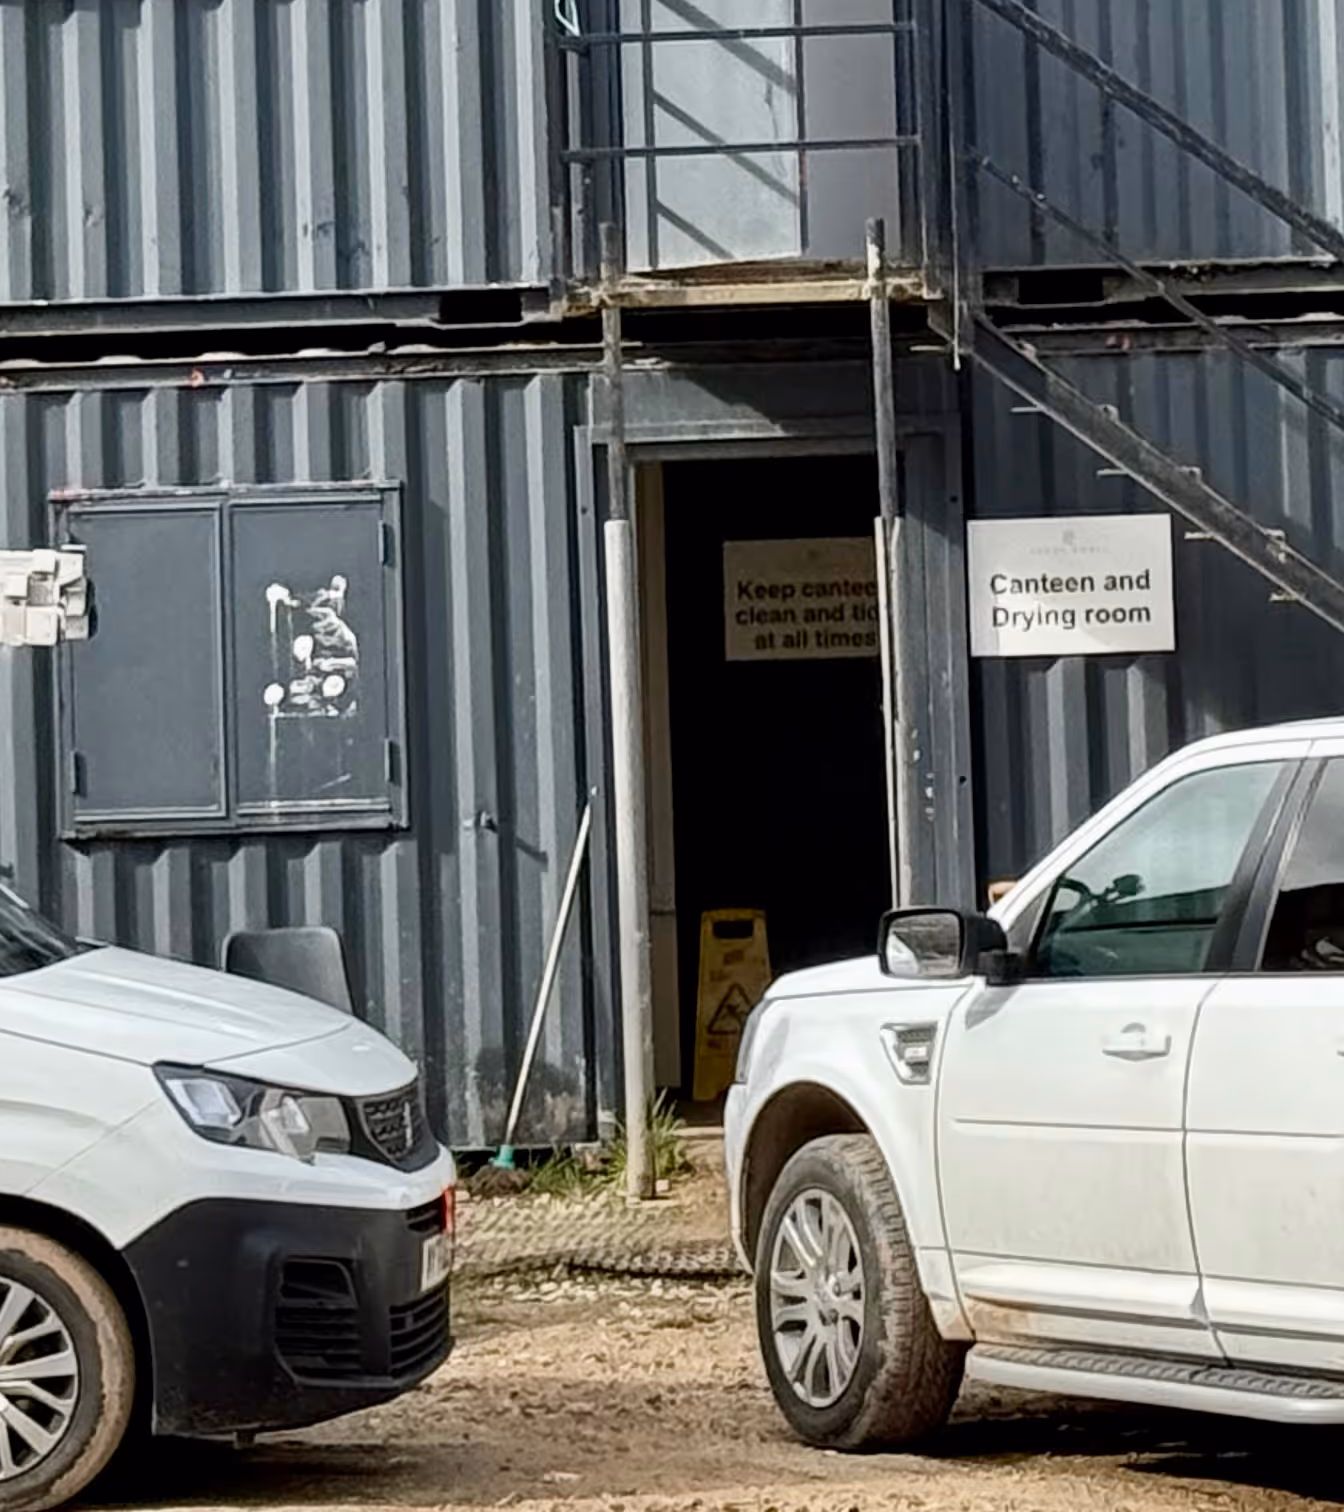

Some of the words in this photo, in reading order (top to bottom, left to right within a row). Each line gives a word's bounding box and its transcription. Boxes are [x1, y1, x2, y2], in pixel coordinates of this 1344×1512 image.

[736, 581, 796, 602] Keep
[800, 580, 878, 598] cantee
[990, 572, 1095, 595] Canteen
[1103, 568, 1151, 592] and
[735, 606, 796, 625] clean
[803, 604, 845, 622] and
[992, 604, 1076, 632] Drying
[1085, 605, 1151, 624] room
[755, 633, 774, 650] at
[781, 629, 807, 649] all
[814, 628, 876, 648] times
